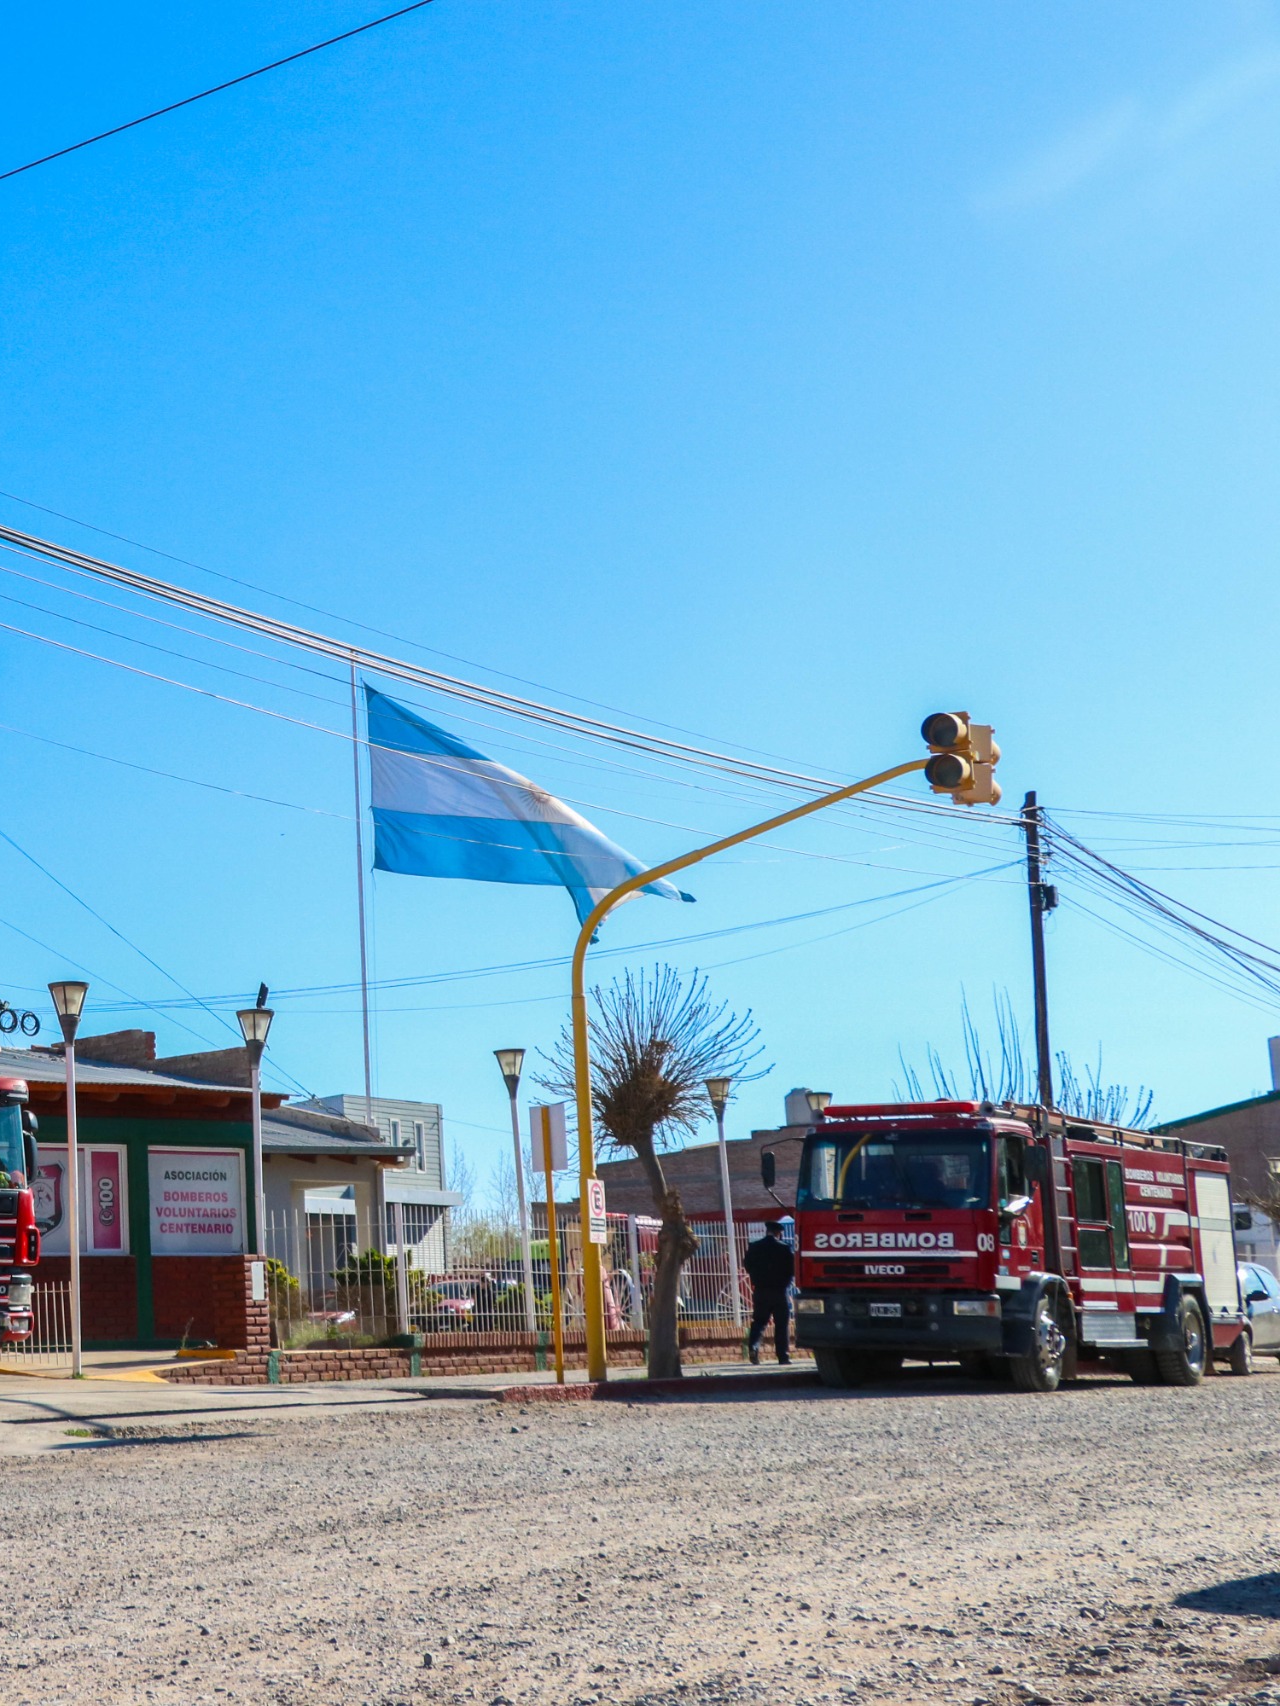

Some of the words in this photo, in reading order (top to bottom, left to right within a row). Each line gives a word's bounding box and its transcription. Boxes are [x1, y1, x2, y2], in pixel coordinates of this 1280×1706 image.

[164, 1169, 227, 1181] ASOCIACIÓN
[1125, 1168, 1154, 1181] BOMBEROS
[99, 1177, 114, 1209] 100
[163, 1191, 228, 1203] BOMBEROS
[1140, 1186, 1172, 1198] CENTENARIO
[156, 1207, 237, 1219] VOLUNTARIOS
[1128, 1211, 1147, 1233] 100
[160, 1223, 234, 1234] CENTENARIO
[977, 1233, 995, 1252] 08
[864, 1264, 905, 1275] IVECO
